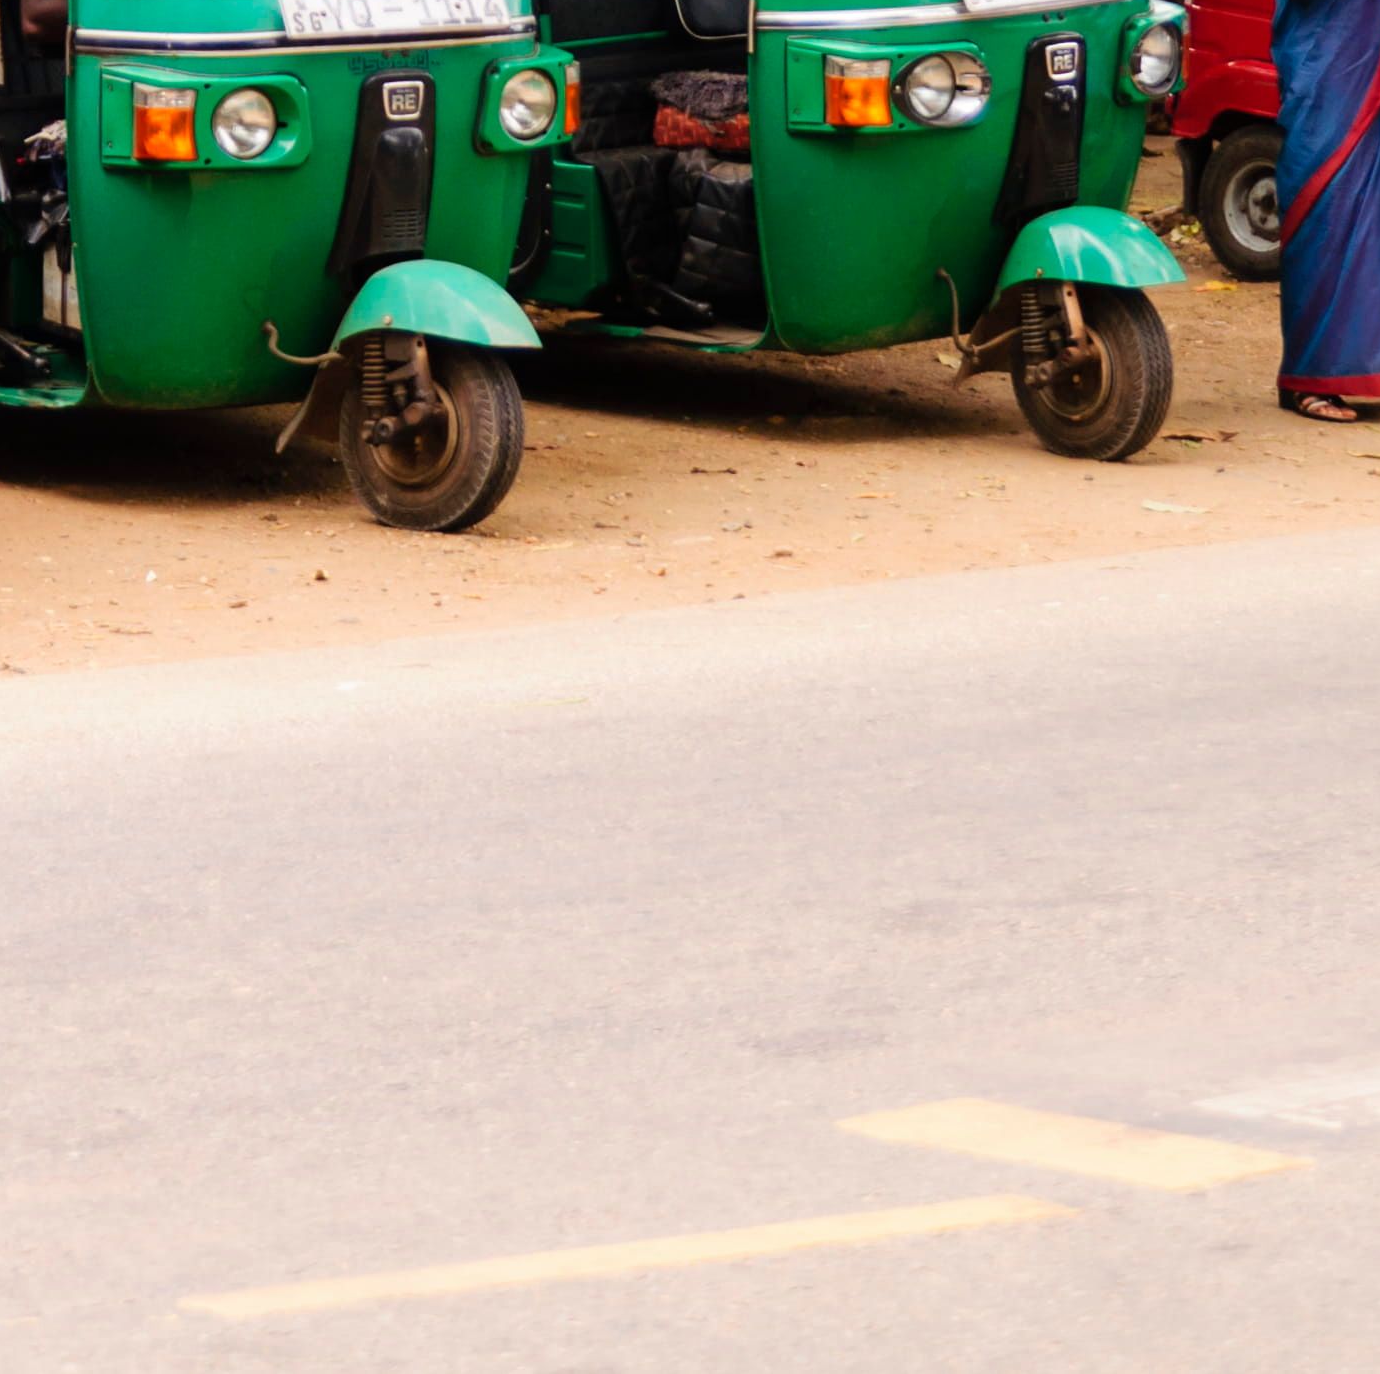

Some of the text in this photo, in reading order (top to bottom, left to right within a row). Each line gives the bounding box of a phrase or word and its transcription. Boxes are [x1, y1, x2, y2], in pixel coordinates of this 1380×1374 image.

[292, 12, 323, 34] SG
[1053, 54, 1074, 72] RE
[390, 93, 417, 112] RE
